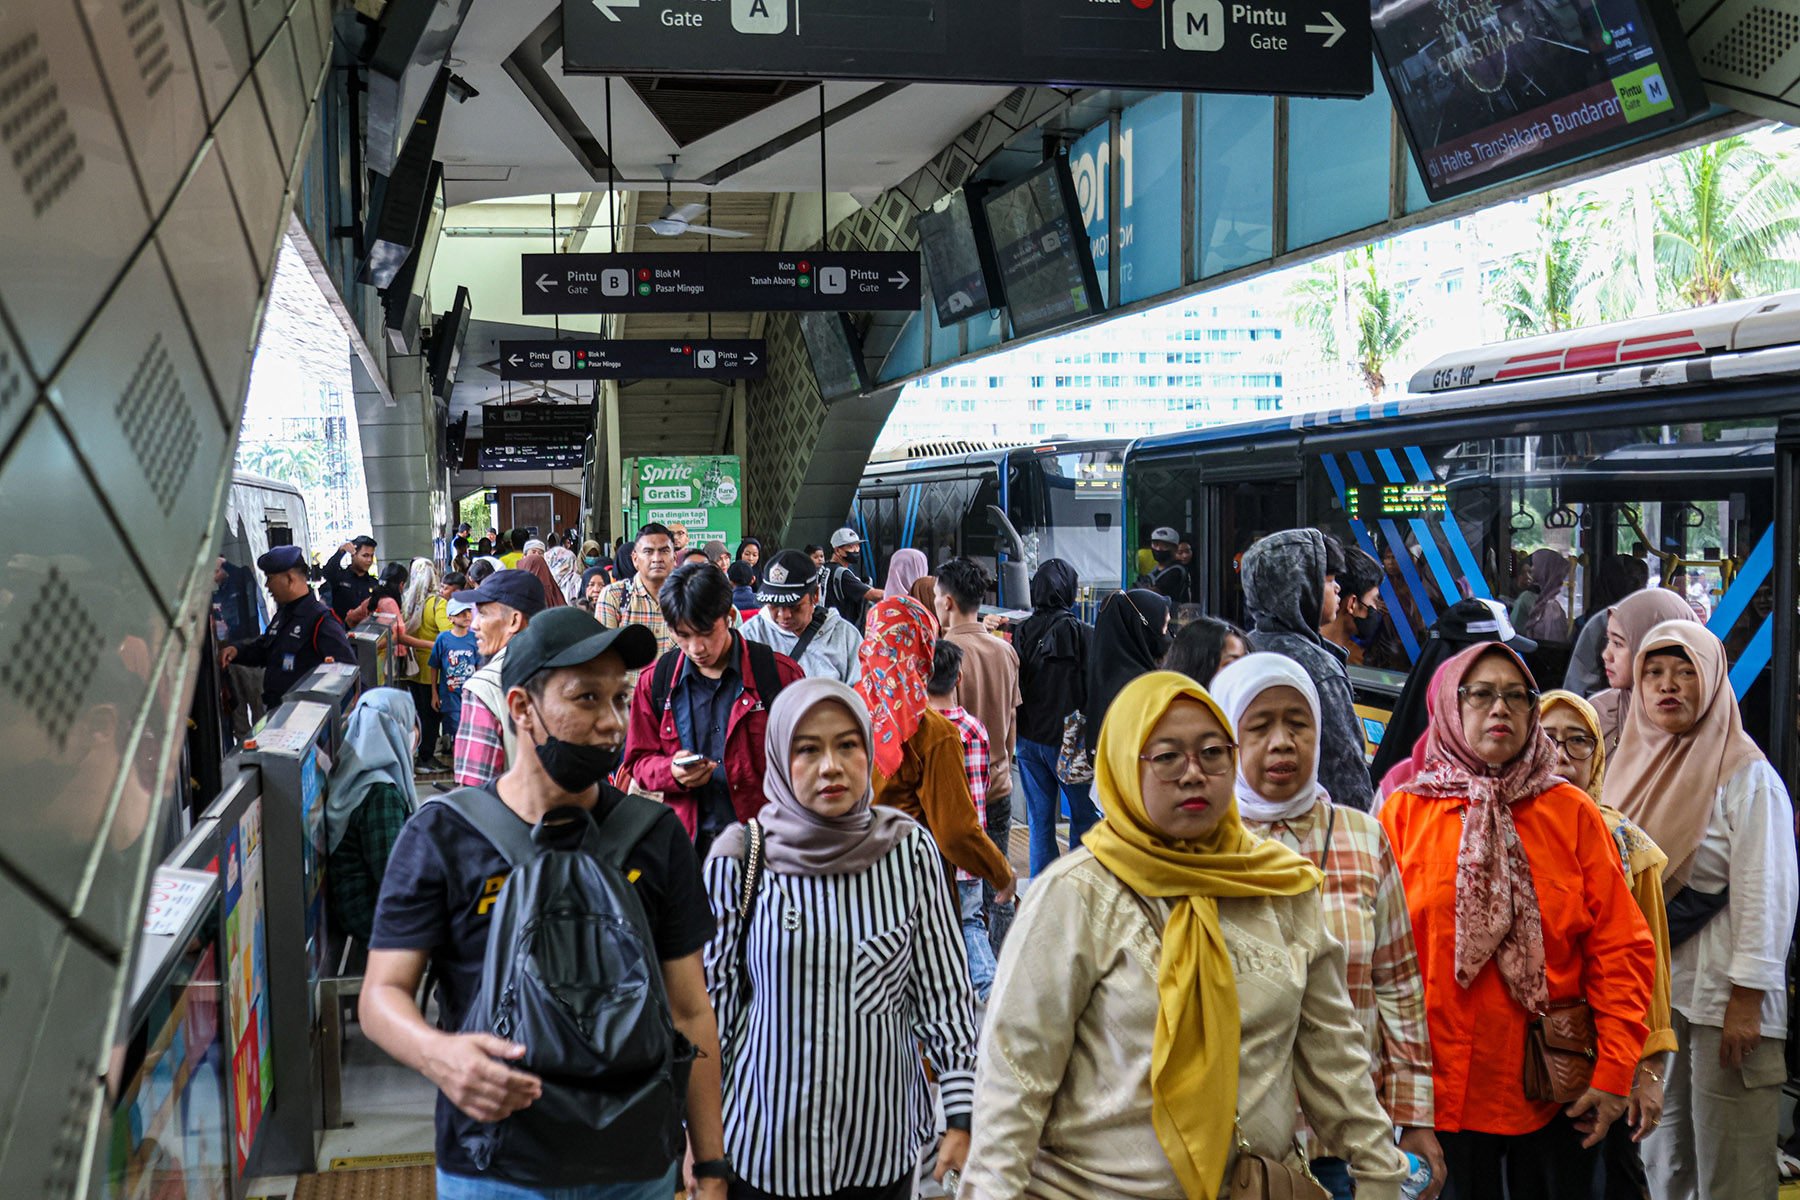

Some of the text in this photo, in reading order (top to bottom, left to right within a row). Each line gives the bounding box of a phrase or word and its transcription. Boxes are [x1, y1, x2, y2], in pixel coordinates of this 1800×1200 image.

[749, 0, 769, 18] A
[661, 9, 703, 27] Gate
[1232, 4, 1287, 26] Pintu
[1186, 12, 1209, 36] M
[1250, 33, 1288, 51] Gate
[1437, 20, 1525, 76] CHRISTMAS
[1619, 84, 1643, 99] Pintu
[1649, 81, 1663, 98] M
[1624, 98, 1641, 111] Gate
[1427, 158, 1441, 178] di
[1440, 149, 1474, 174] Halte
[778, 262, 796, 271] Kota
[567, 271, 597, 282] Pintu
[655, 269, 680, 278] Blok M
[850, 269, 879, 280] Pintu
[610, 277, 619, 289] B
[750, 276, 772, 285] Tanah
[772, 276, 796, 287] Abang
[829, 274, 837, 287] L
[567, 285, 588, 295] Gate
[655, 284, 705, 294] Pasar Minggu
[859, 283, 879, 293] Gate
[529, 352, 550, 360] Pintu
[558, 356, 565, 364] C
[703, 355, 710, 364] K
[718, 351, 738, 359] Pintu
[1460, 365, 1476, 385] HP
[640, 463, 692, 484] Sprite
[648, 489, 687, 499] Gratis
[665, 511, 689, 519] dingin
[691, 511, 706, 519] tapi
